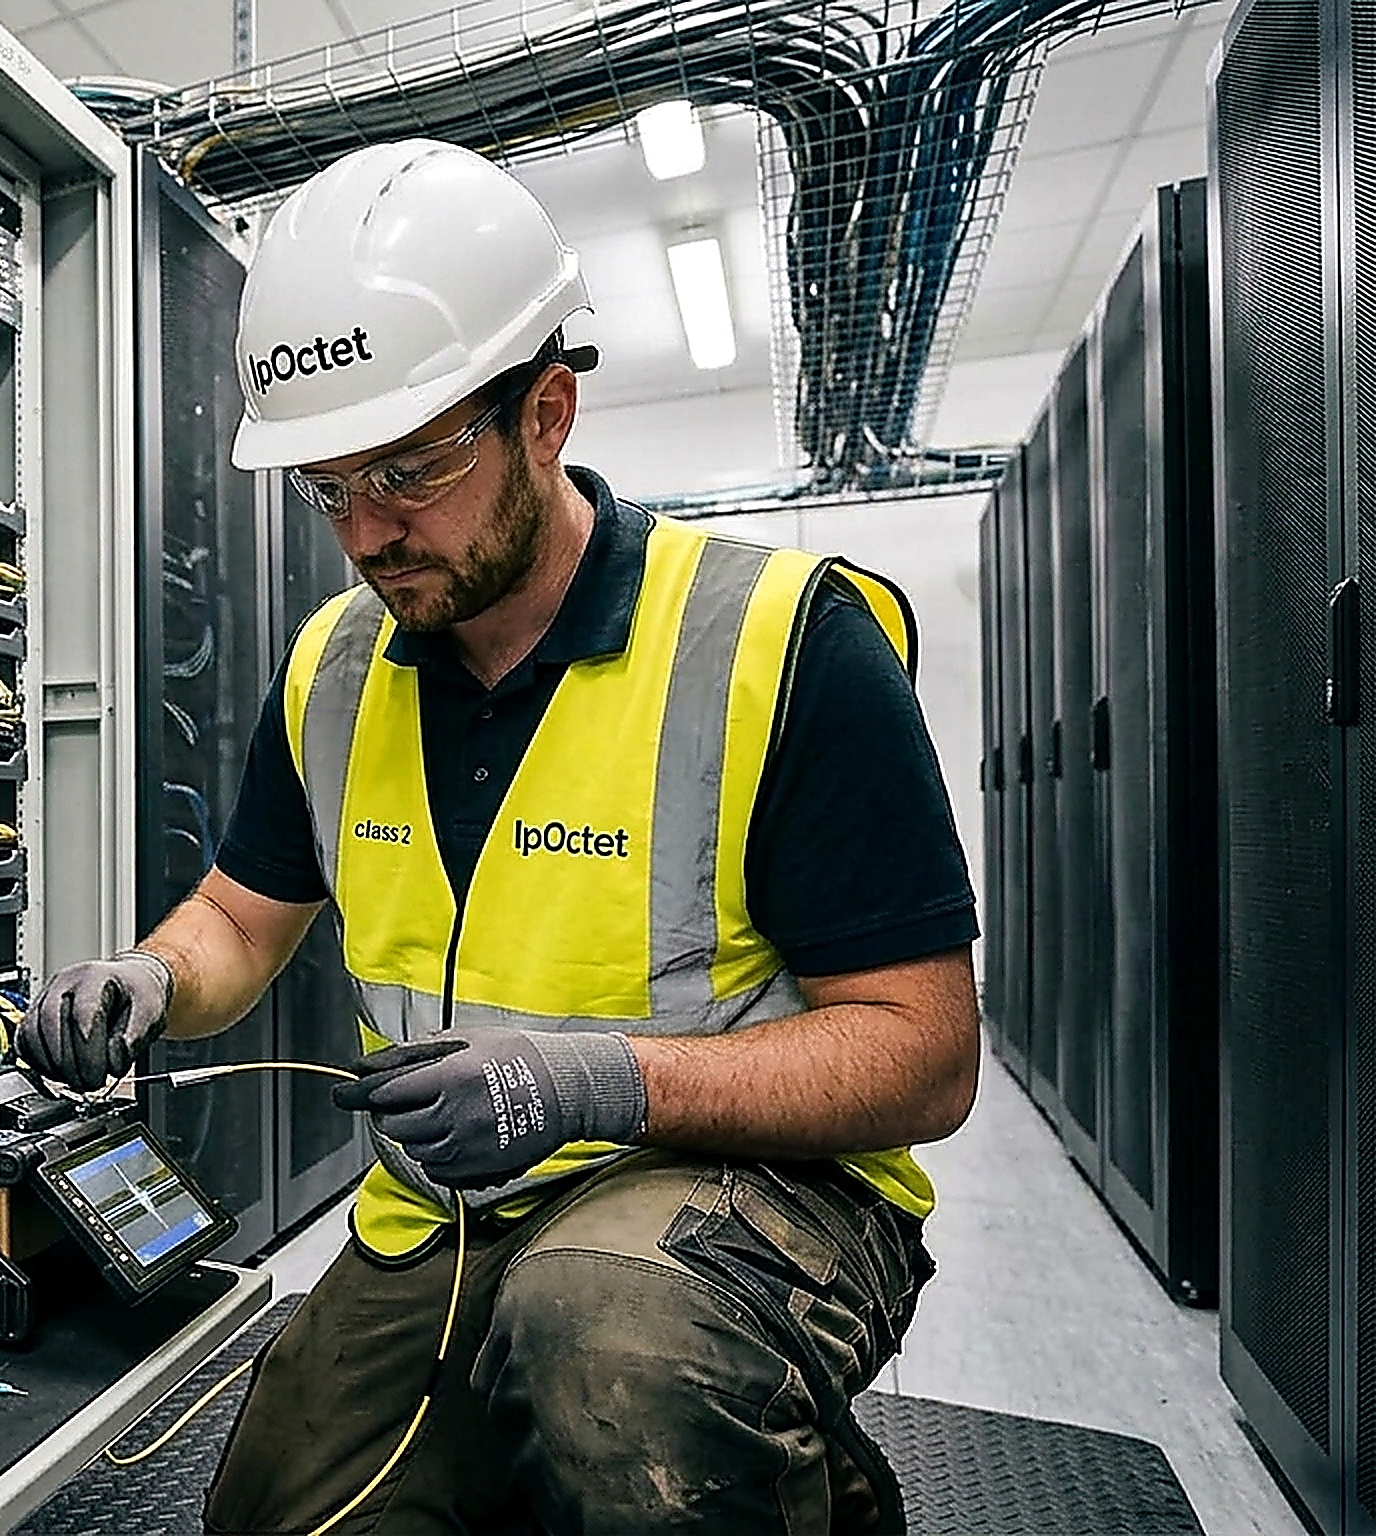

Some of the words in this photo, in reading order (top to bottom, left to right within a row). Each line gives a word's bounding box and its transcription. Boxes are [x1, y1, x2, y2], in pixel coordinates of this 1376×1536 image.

[249, 327, 372, 395] IpOctet
[355, 820, 399, 842] class
[401, 825, 411, 844] 2
[515, 820, 629, 857] IpOctet
